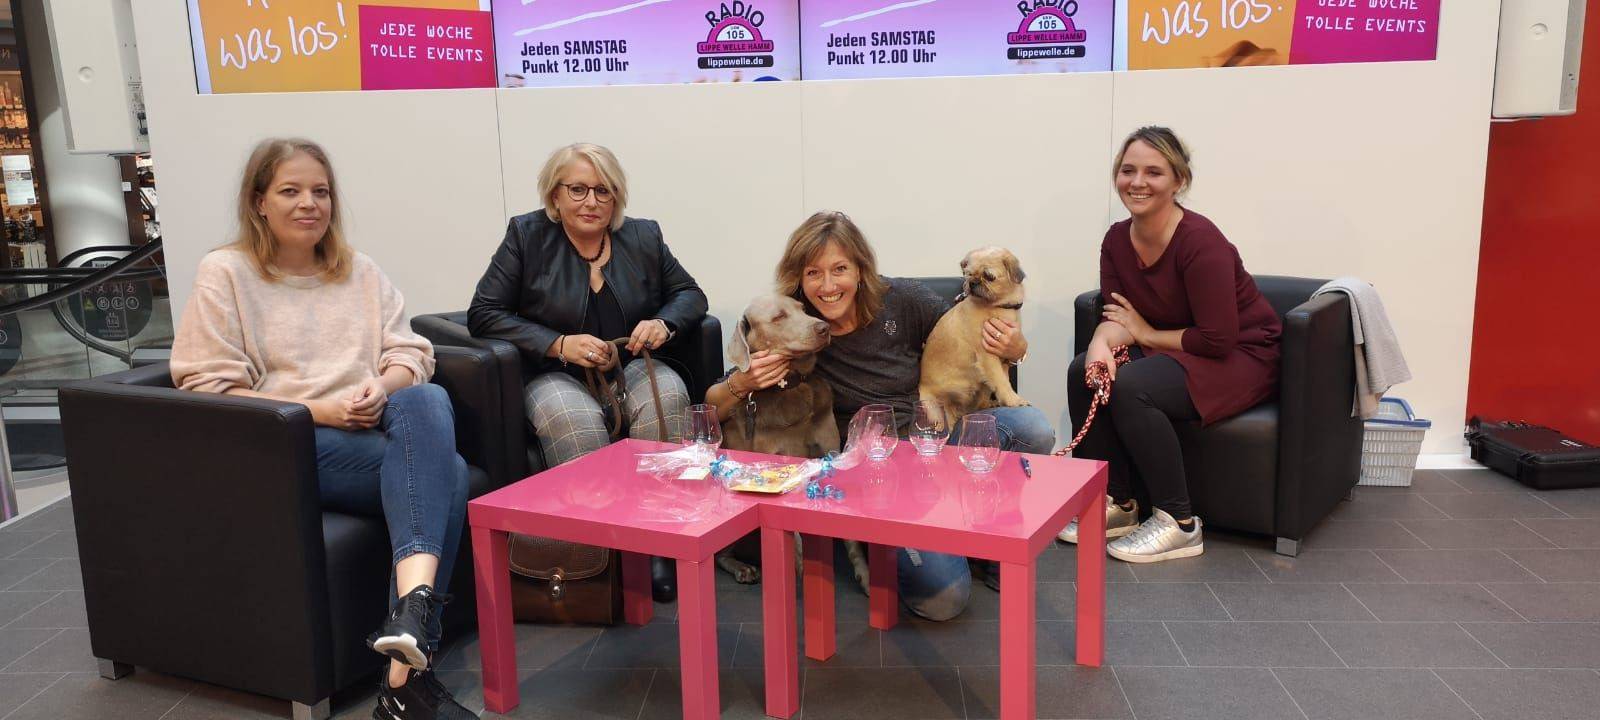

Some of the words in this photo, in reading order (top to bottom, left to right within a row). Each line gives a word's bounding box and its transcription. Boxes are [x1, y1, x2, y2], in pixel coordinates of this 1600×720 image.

[705, 0, 765, 28] RADIO
[1141, 0, 1209, 45] was
[379, 22, 417, 37] JEDE
[426, 25, 473, 40] WOCHE
[1038, 20, 1057, 30] 105
[1305, 15, 1355, 31] TOLLE
[1365, 18, 1426, 33] EVENTS
[220, 27, 282, 70] was
[287, 1, 348, 56] los!
[726, 30, 745, 40] 105
[826, 32, 867, 48] Jeden
[870, 30, 936, 47] SAMSTAG
[1011, 34, 1033, 42] LIPPE
[1034, 33, 1058, 41] WELLE
[1060, 32, 1084, 41] HAMM
[370, 43, 417, 59] TOLLE
[427, 46, 483, 62] EVENTS
[520, 41, 560, 57] Jeden
[563, 39, 627, 56] SAMSTAG
[700, 44, 721, 52] LIPPE
[722, 43, 746, 51] WELLE
[748, 42, 771, 50] HAMM
[1017, 47, 1076, 59] lippewelle.de
[522, 59, 560, 74] Punkt
[563, 57, 602, 73] 12.00
[605, 57, 630, 72] Uhr
[707, 56, 764, 68] lippewelle.de
[827, 50, 865, 66] Punkt
[869, 48, 908, 65] 12.00
[912, 48, 937, 63] Uhr
